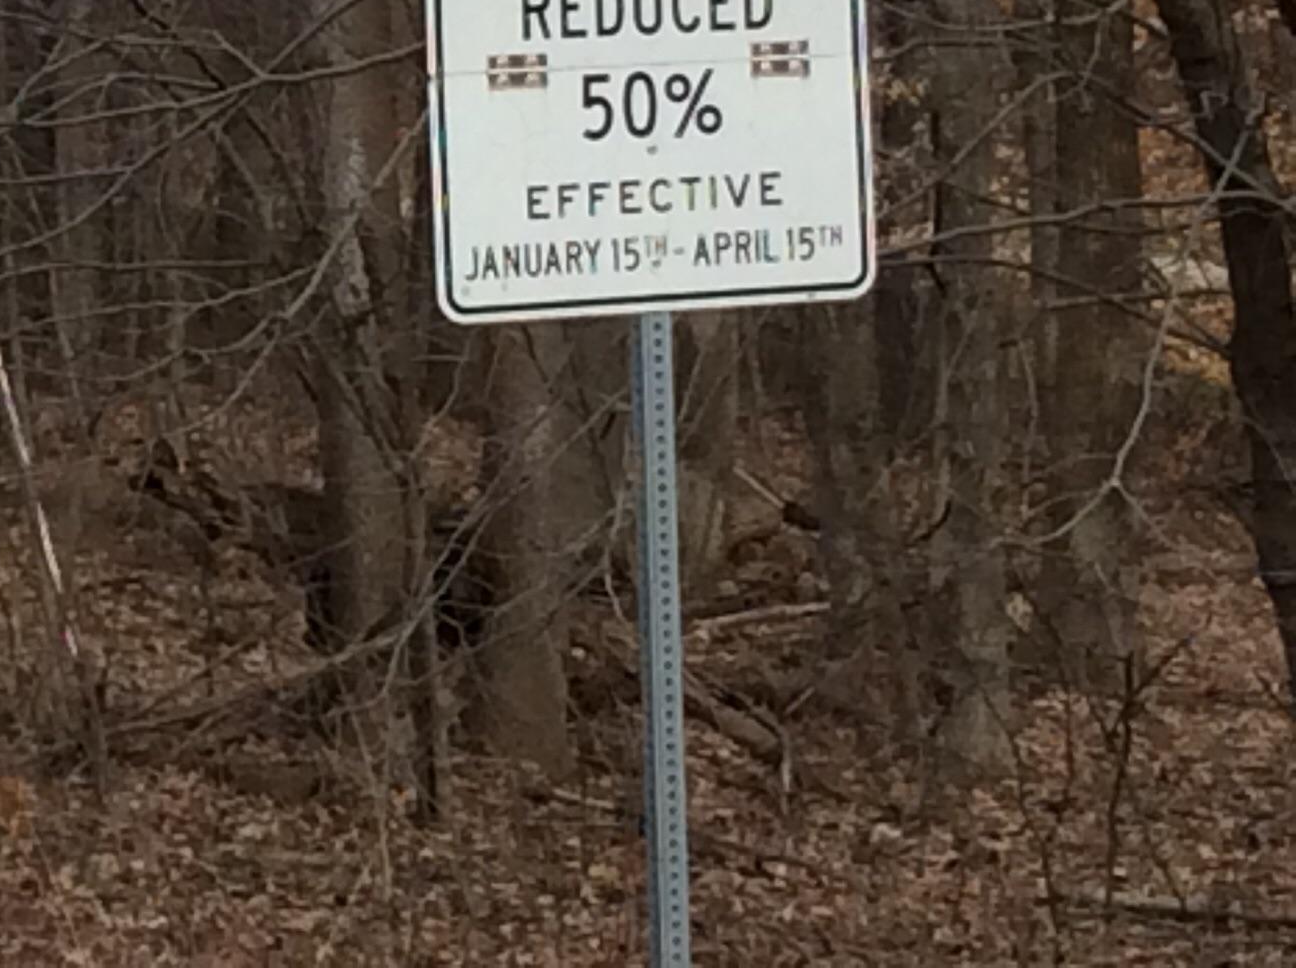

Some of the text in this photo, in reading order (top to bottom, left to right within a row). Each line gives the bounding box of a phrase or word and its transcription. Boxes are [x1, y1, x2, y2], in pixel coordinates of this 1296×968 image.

[581, 68, 723, 141] 50%
[526, 171, 783, 220] EFFECTIVE
[464, 240, 600, 282] JANUARY
[693, 228, 780, 266] APRIL
